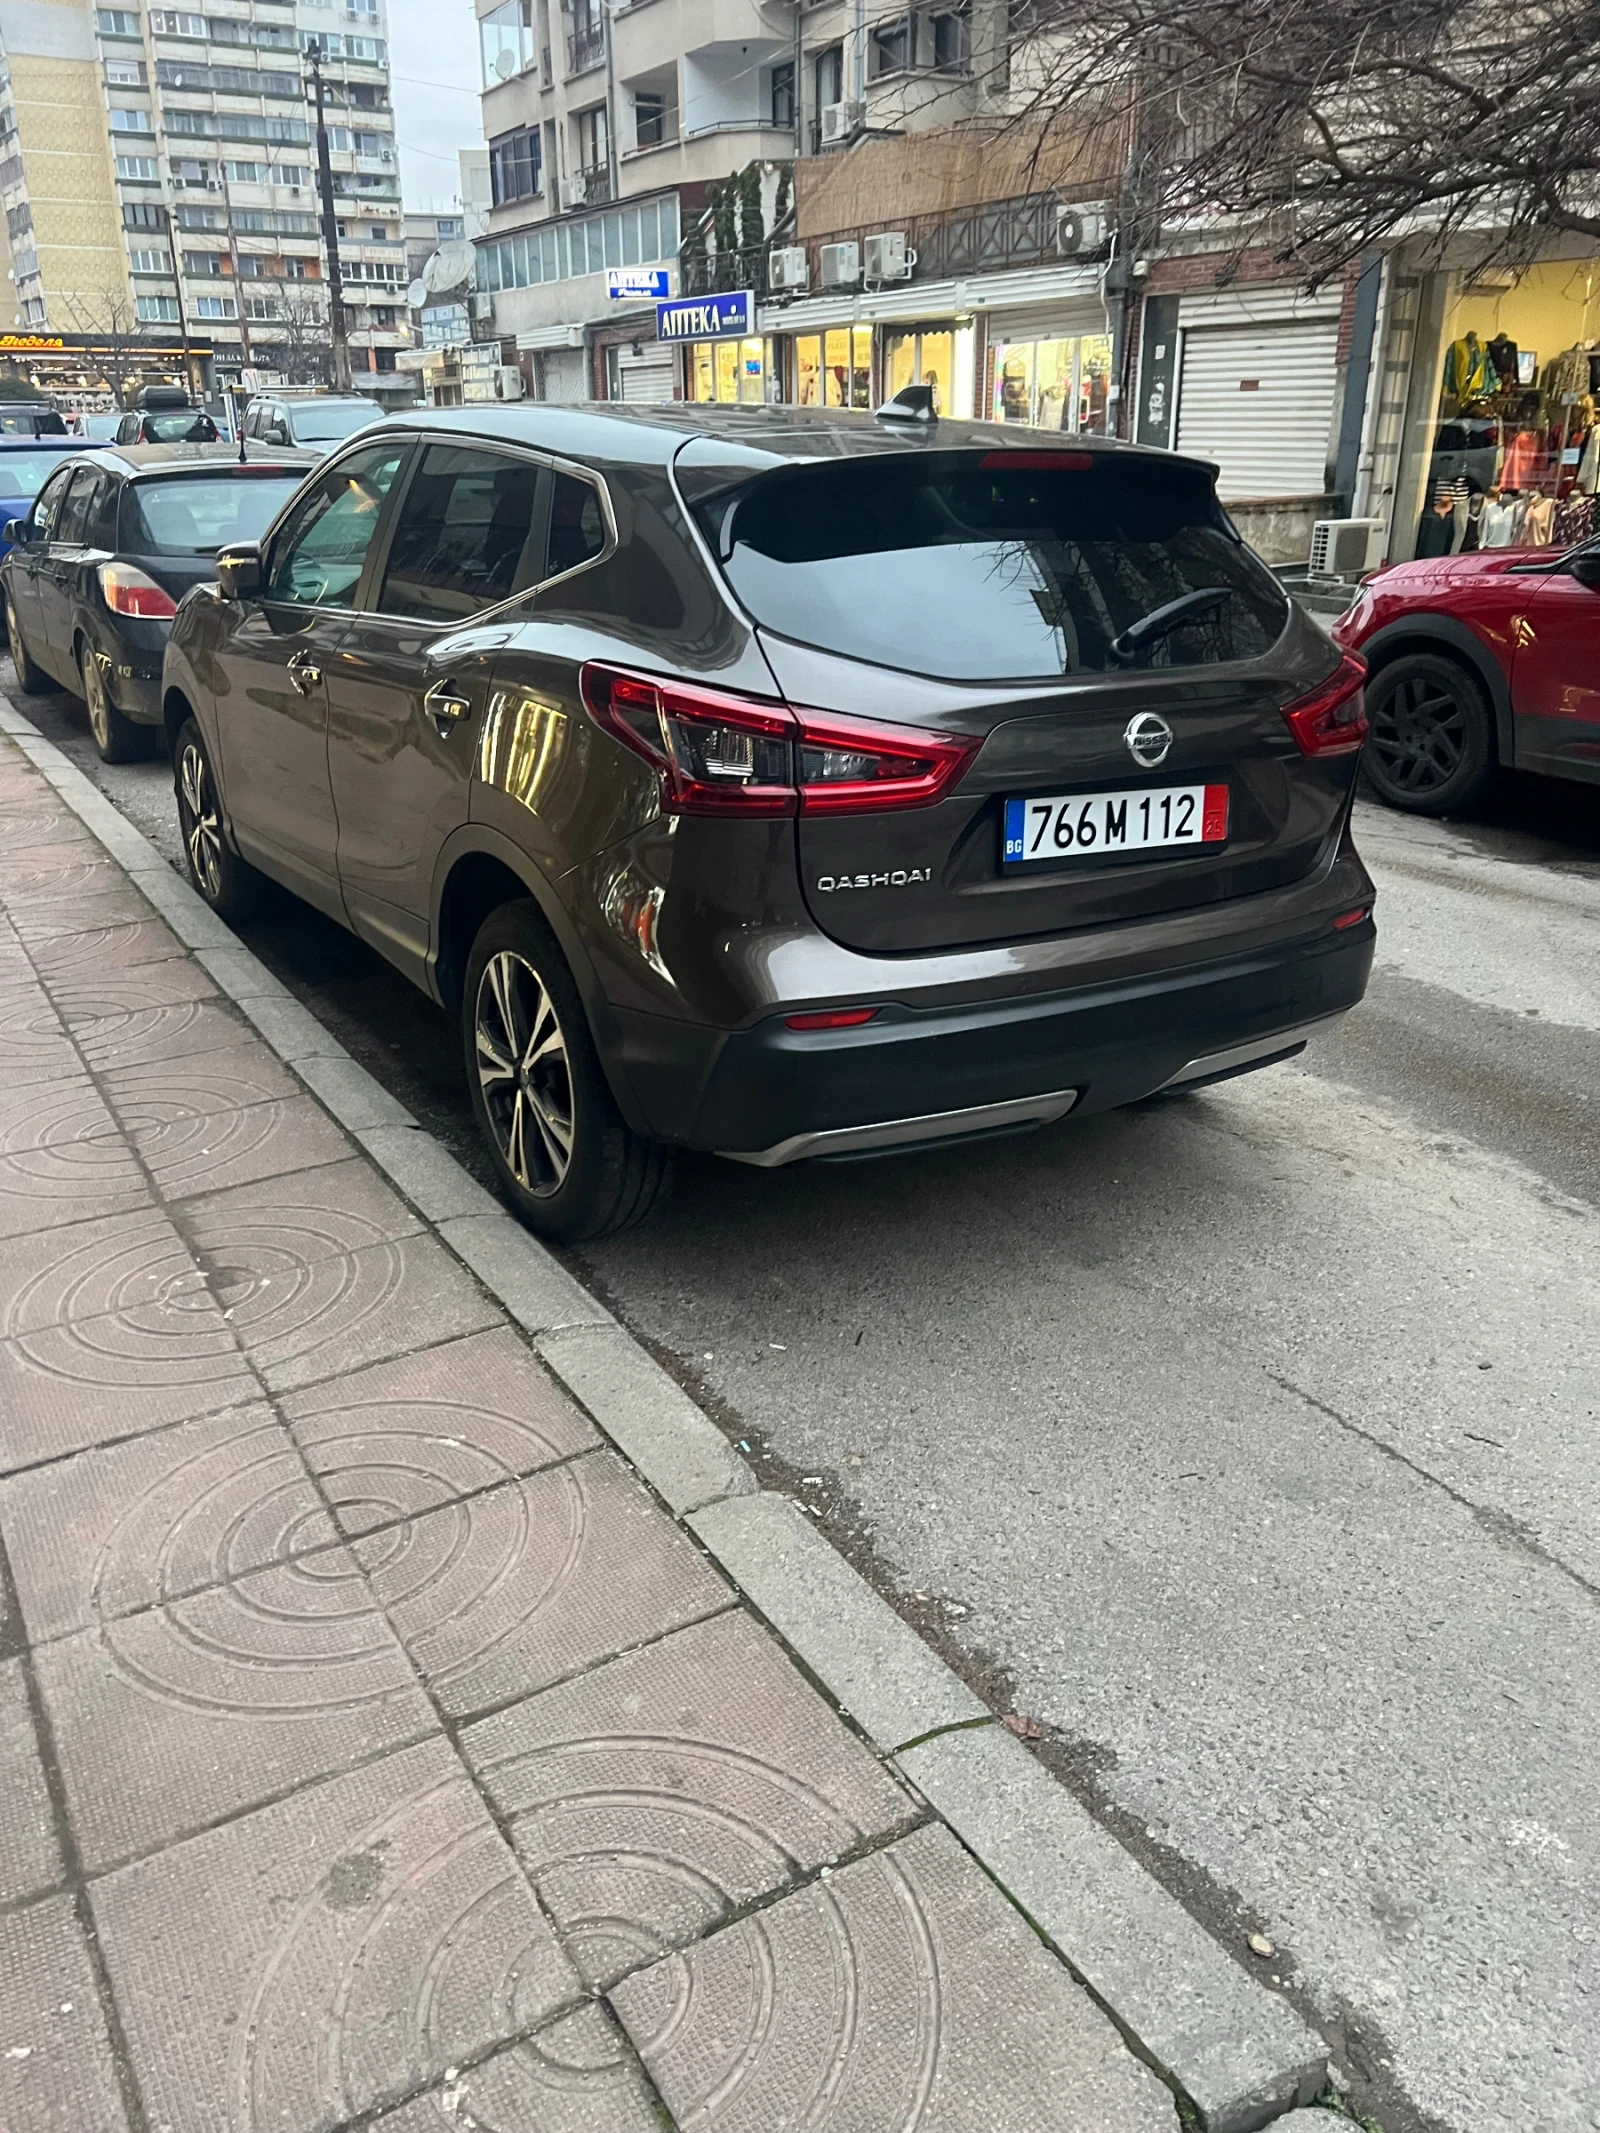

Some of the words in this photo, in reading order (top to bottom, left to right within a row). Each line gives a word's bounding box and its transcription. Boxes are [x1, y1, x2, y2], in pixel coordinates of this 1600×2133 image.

[609, 271, 660, 288] АПТЕКА
[661, 304, 721, 337] АПТЕКА
[1132, 732, 1172, 748] NISSAN
[1006, 839, 1022, 854] BG
[817, 867, 932, 892] QASHQAI
